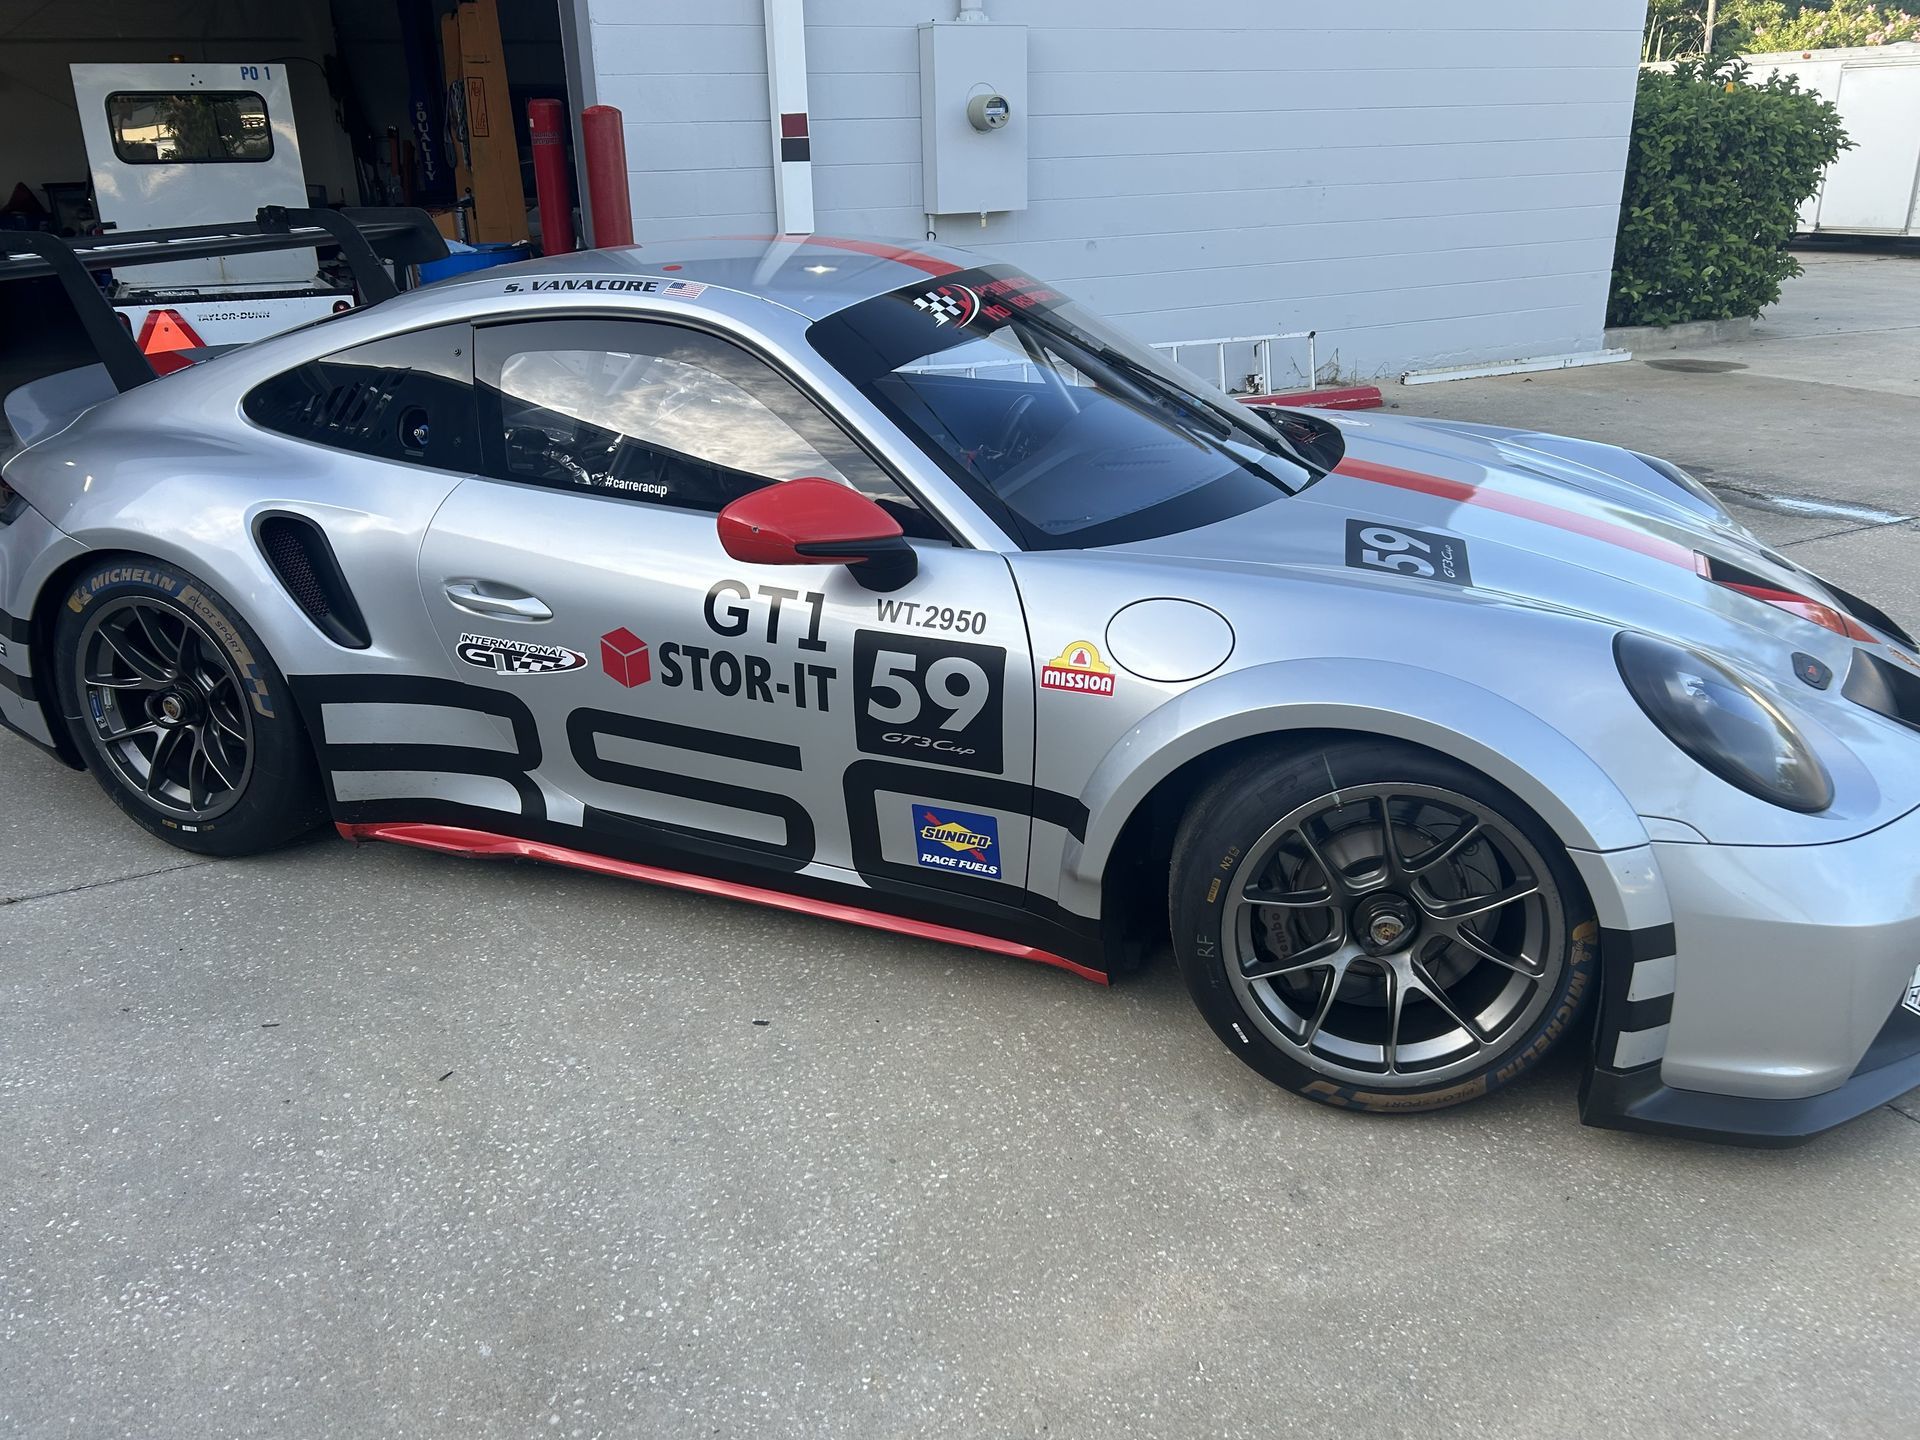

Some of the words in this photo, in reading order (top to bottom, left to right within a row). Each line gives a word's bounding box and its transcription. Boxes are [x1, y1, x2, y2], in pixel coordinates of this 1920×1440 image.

[263, 66, 271, 80] 1
[503, 282, 525, 294] S.
[531, 279, 660, 293] VANACORE
[198, 311, 271, 322] TAYLOR-DUNN
[605, 474, 668, 498] #carreracup
[1359, 527, 1435, 577] 59
[91, 567, 177, 592] MICHELIN
[189, 594, 217, 620] PILOT
[214, 620, 243, 653] SPORT
[703, 578, 827, 652] GT1
[876, 598, 987, 635] WT.2950
[460, 633, 566, 659] INTERNATIONAL
[658, 641, 838, 713] STOR-IT
[1043, 669, 1112, 693] MISSION
[867, 649, 990, 732] 59
[924, 827, 990, 848] SUNOCO
[921, 853, 958, 867] RACE
[959, 860, 998, 875] FUELS
[1496, 971, 1589, 1084] MICHELIN
[1382, 1099, 1431, 1109] SPORT
